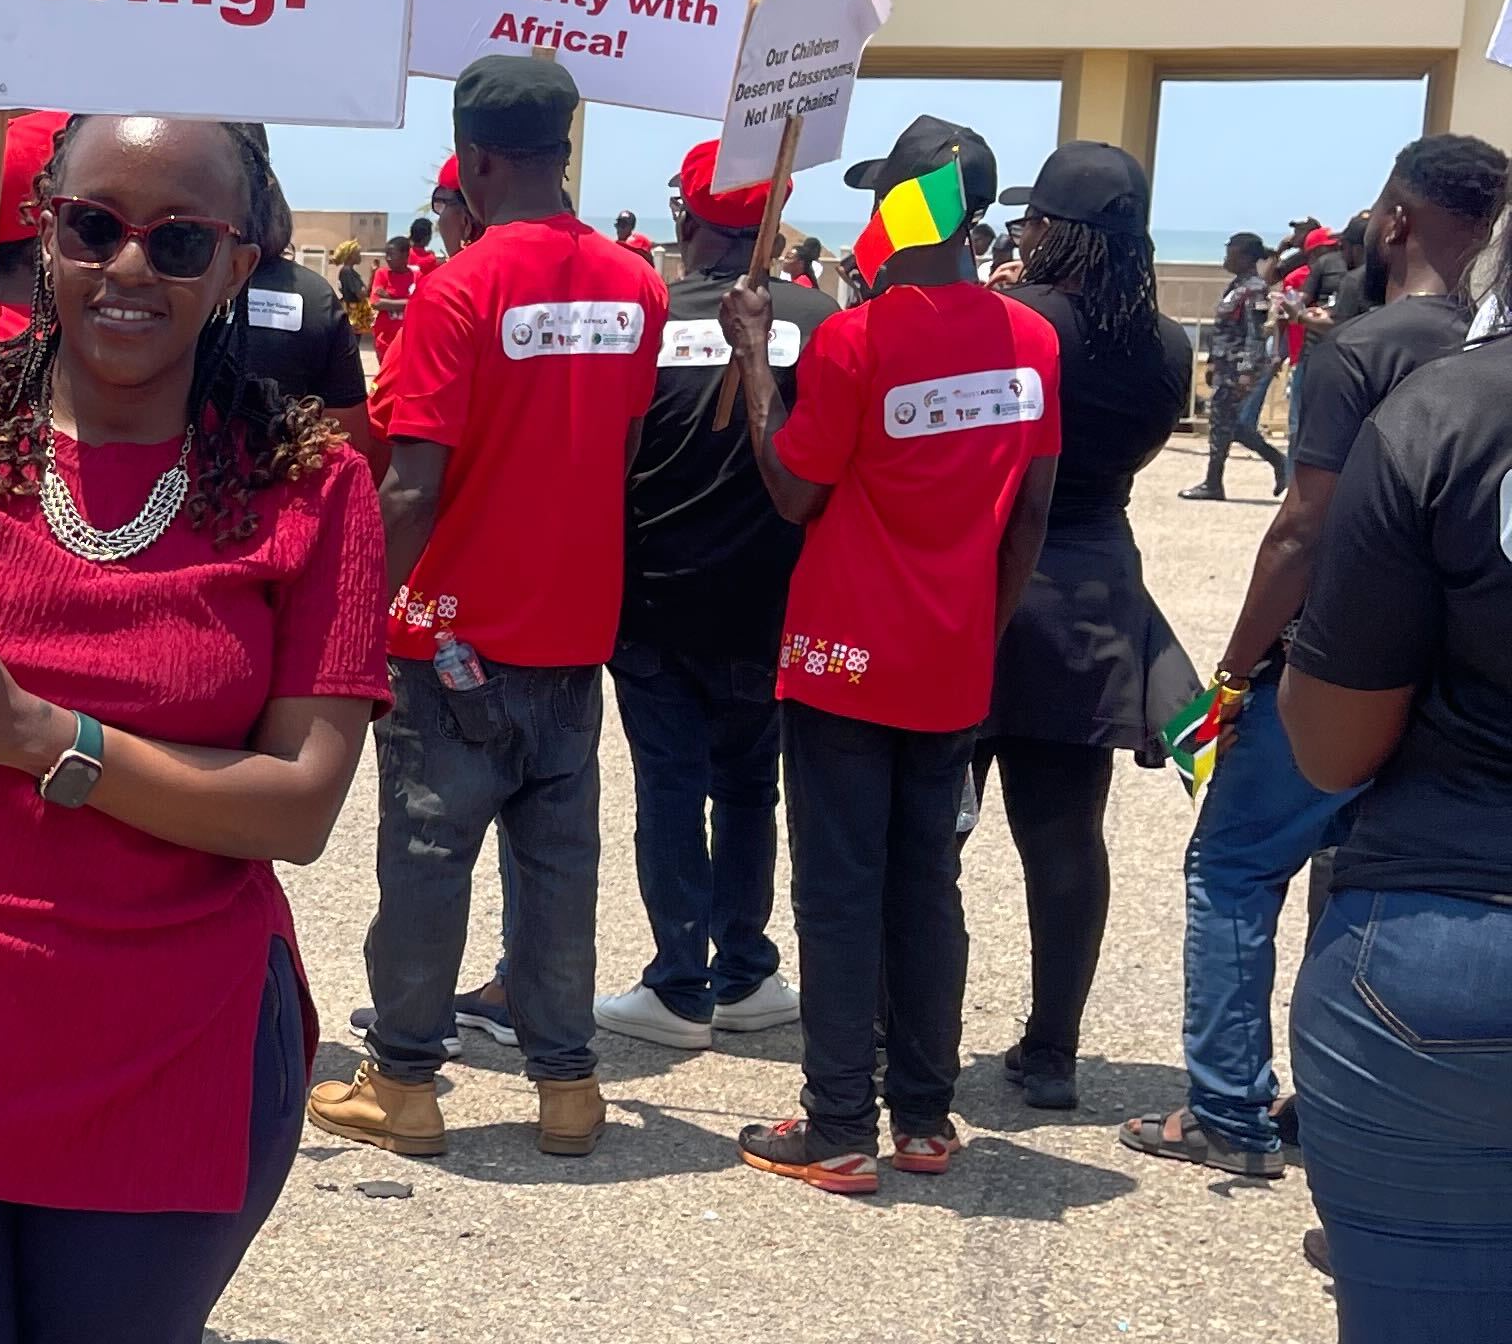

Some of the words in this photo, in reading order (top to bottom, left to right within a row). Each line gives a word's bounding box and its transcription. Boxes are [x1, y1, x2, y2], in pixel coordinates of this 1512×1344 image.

[490, 13, 628, 58] Africa!
[766, 49, 789, 67] Our
[791, 38, 839, 61] Children
[735, 78, 785, 102] Deserve
[789, 62, 856, 89] Classrooms,
[744, 105, 768, 127] Not
[769, 99, 794, 122] IMF
[796, 88, 839, 115] Chains!
